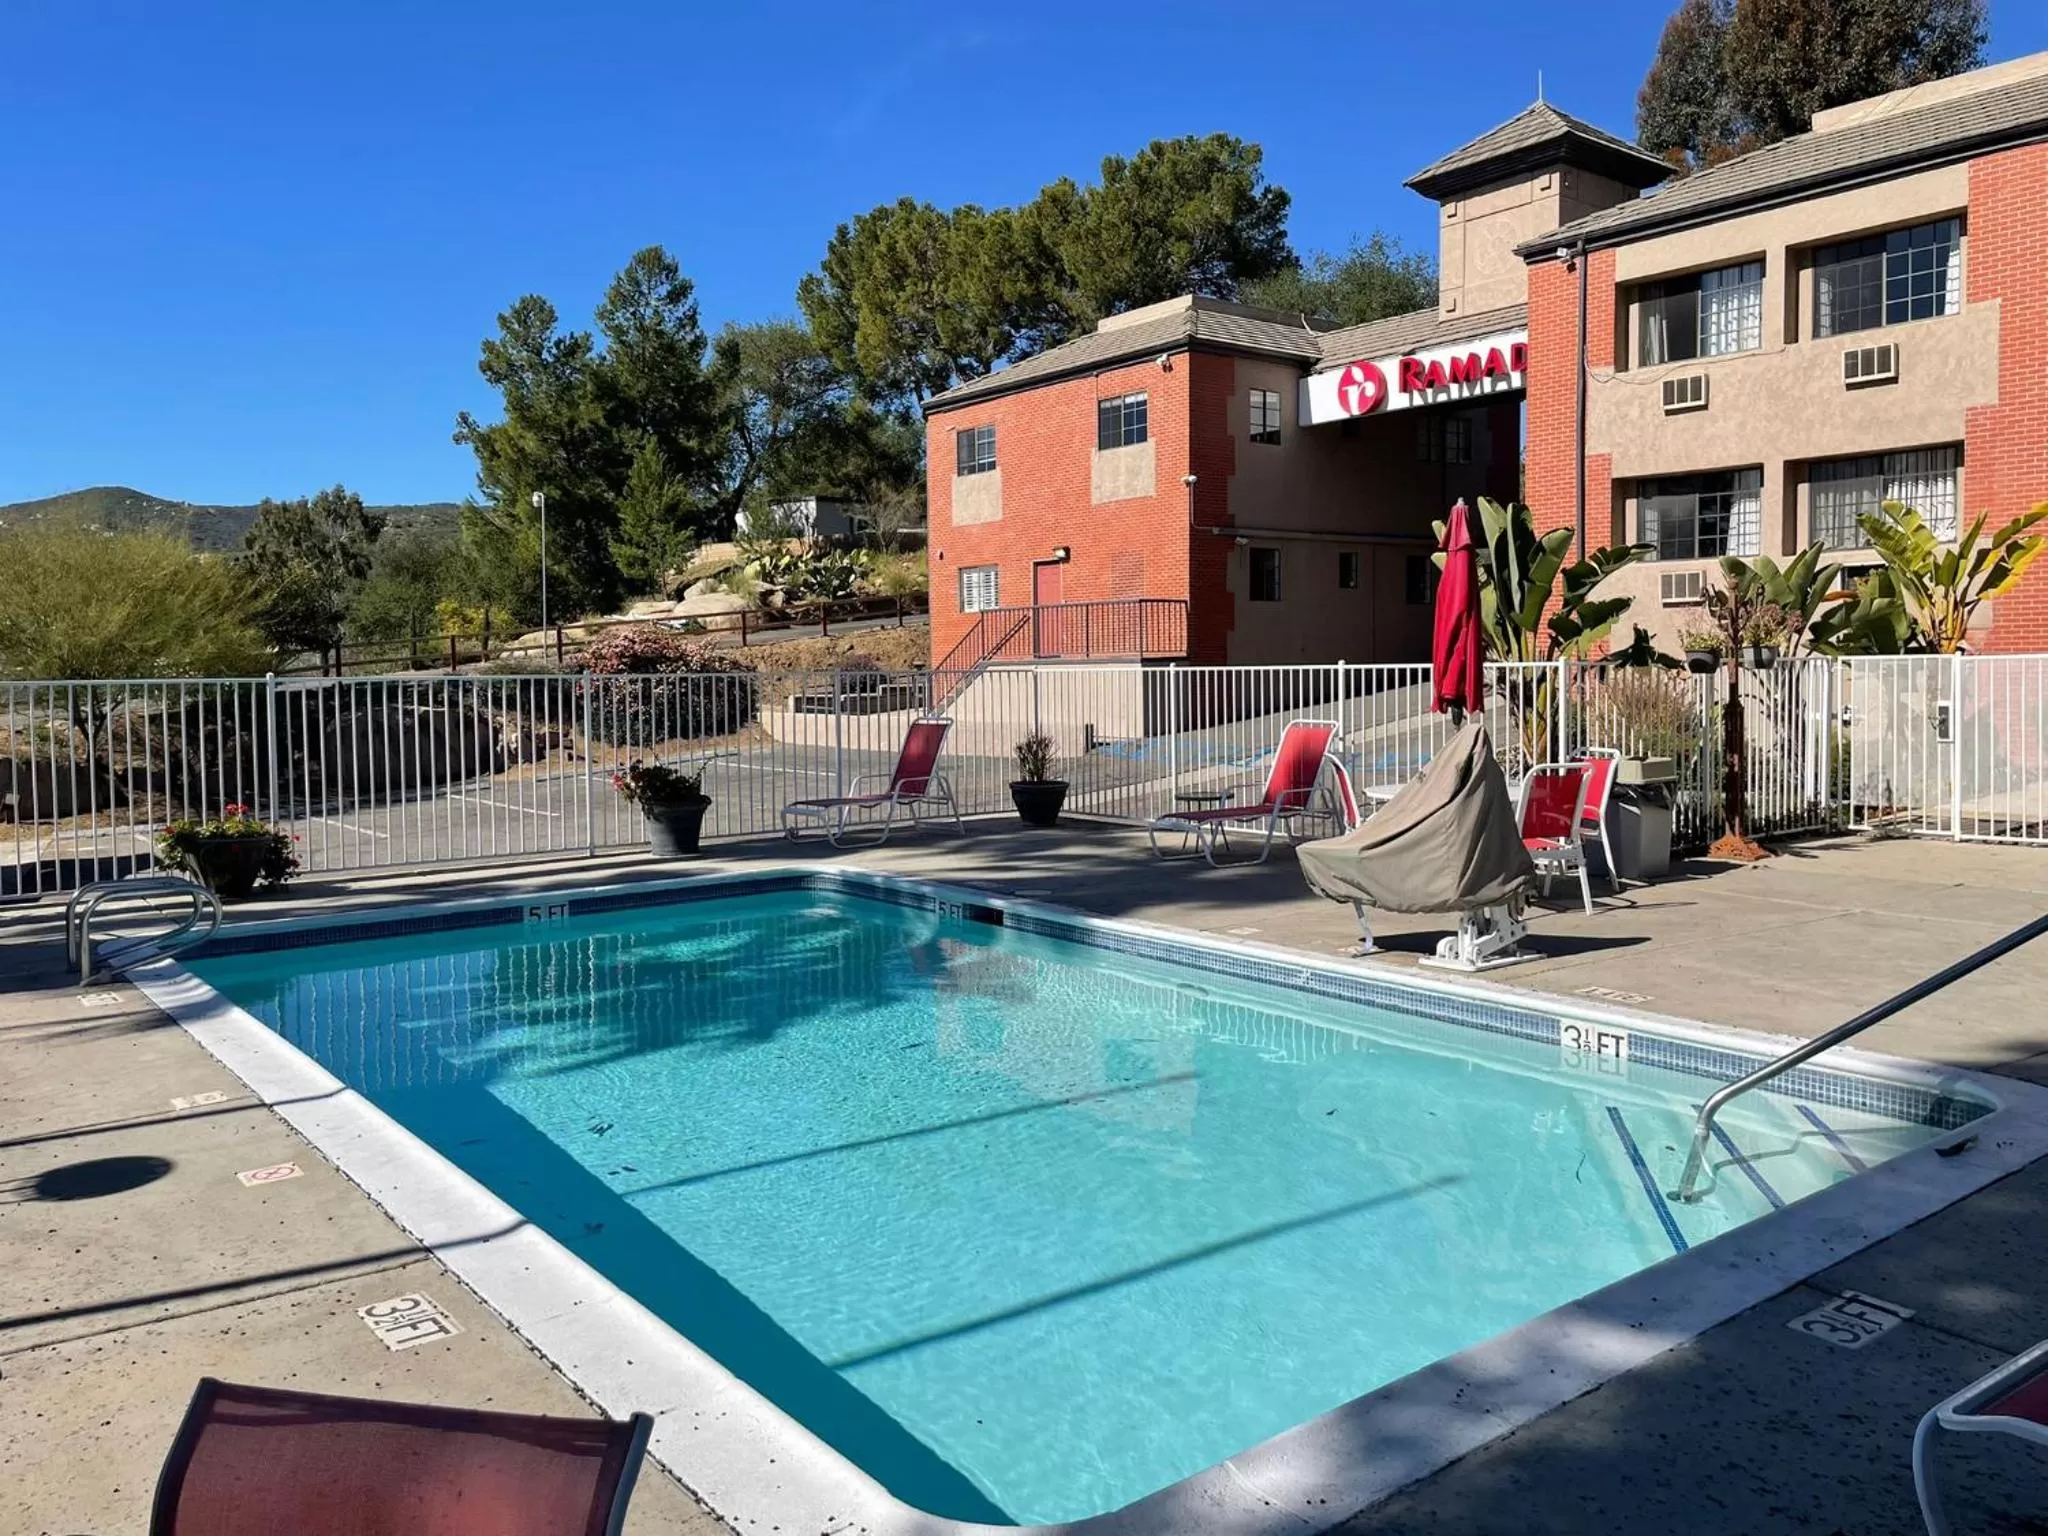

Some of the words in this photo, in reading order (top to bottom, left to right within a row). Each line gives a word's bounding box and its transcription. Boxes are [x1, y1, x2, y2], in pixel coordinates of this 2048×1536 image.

[529, 906, 542, 920] 5
[548, 904, 567, 920] FT
[1597, 1032, 1625, 1058] FT
[1832, 1294, 1901, 1331] FT
[385, 1316, 452, 1344] FT
